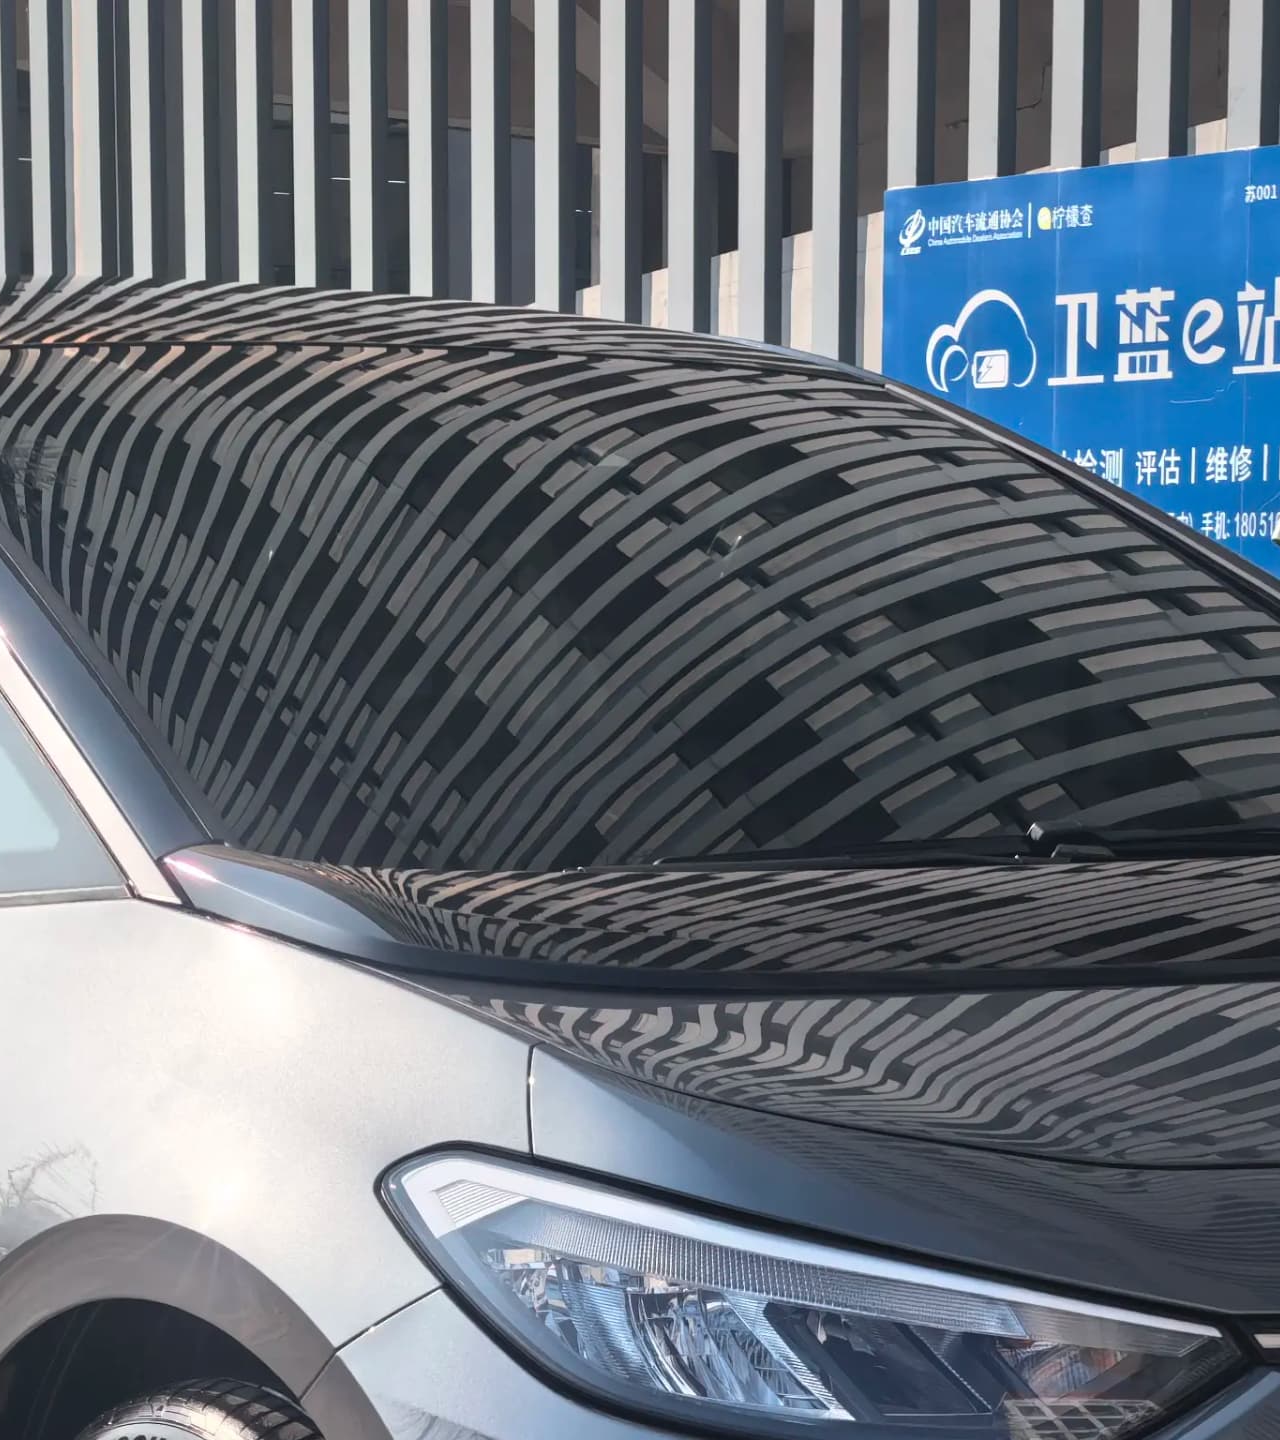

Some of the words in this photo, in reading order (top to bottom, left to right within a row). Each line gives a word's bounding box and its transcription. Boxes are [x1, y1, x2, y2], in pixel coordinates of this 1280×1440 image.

[1245, 185, 1277, 203] 苏001
[928, 207, 1024, 237] 中国汽车流通协会
[1052, 204, 1094, 230] 柠檬查
[1061, 448, 1123, 488] 检测
[1136, 448, 1181, 486] 评估
[1206, 445, 1253, 483] 维修
